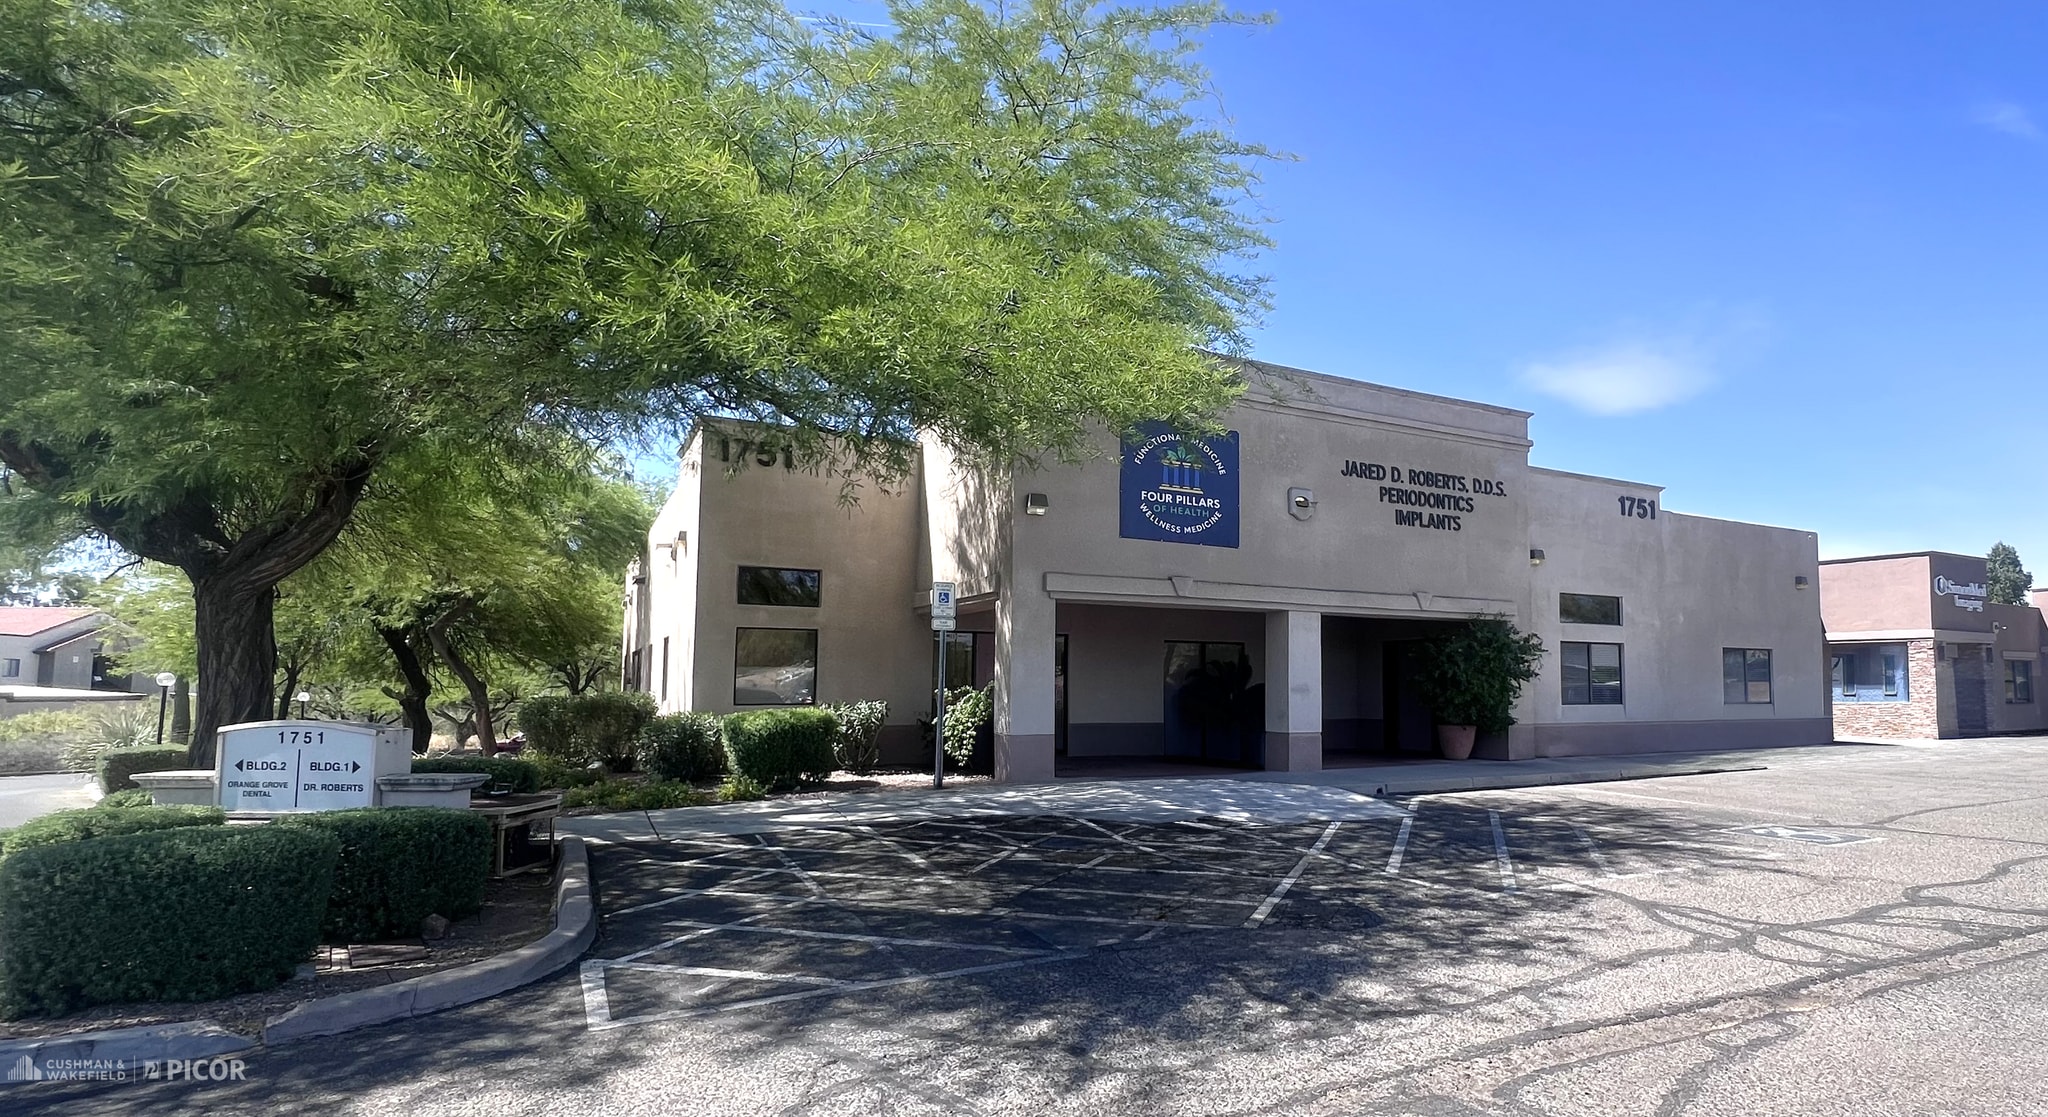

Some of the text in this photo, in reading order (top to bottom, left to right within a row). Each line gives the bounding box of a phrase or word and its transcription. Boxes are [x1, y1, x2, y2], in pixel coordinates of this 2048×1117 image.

[1190, 437, 1227, 476] MEDICINE
[1341, 460, 1508, 498] JARED D. ROBERTS, D.D.S.
[1141, 490, 1221, 509] FOUR PILLARS
[1379, 486, 1475, 513] PERIODONTICS
[1153, 504, 1210, 518] OF HEALTH
[1618, 496, 1656, 520] 1751
[1140, 503, 1223, 534] WELLNESS MEDICINE
[1395, 509, 1462, 531] IMPLANTS
[278, 731, 324, 744] 1751
[246, 761, 287, 771] BLDG.2
[310, 762, 349, 772] BLDG.1
[227, 781, 289, 789] ORANGE GROVE
[303, 783, 364, 792] DR. ROBERTS
[242, 790, 272, 798] DENTAL
